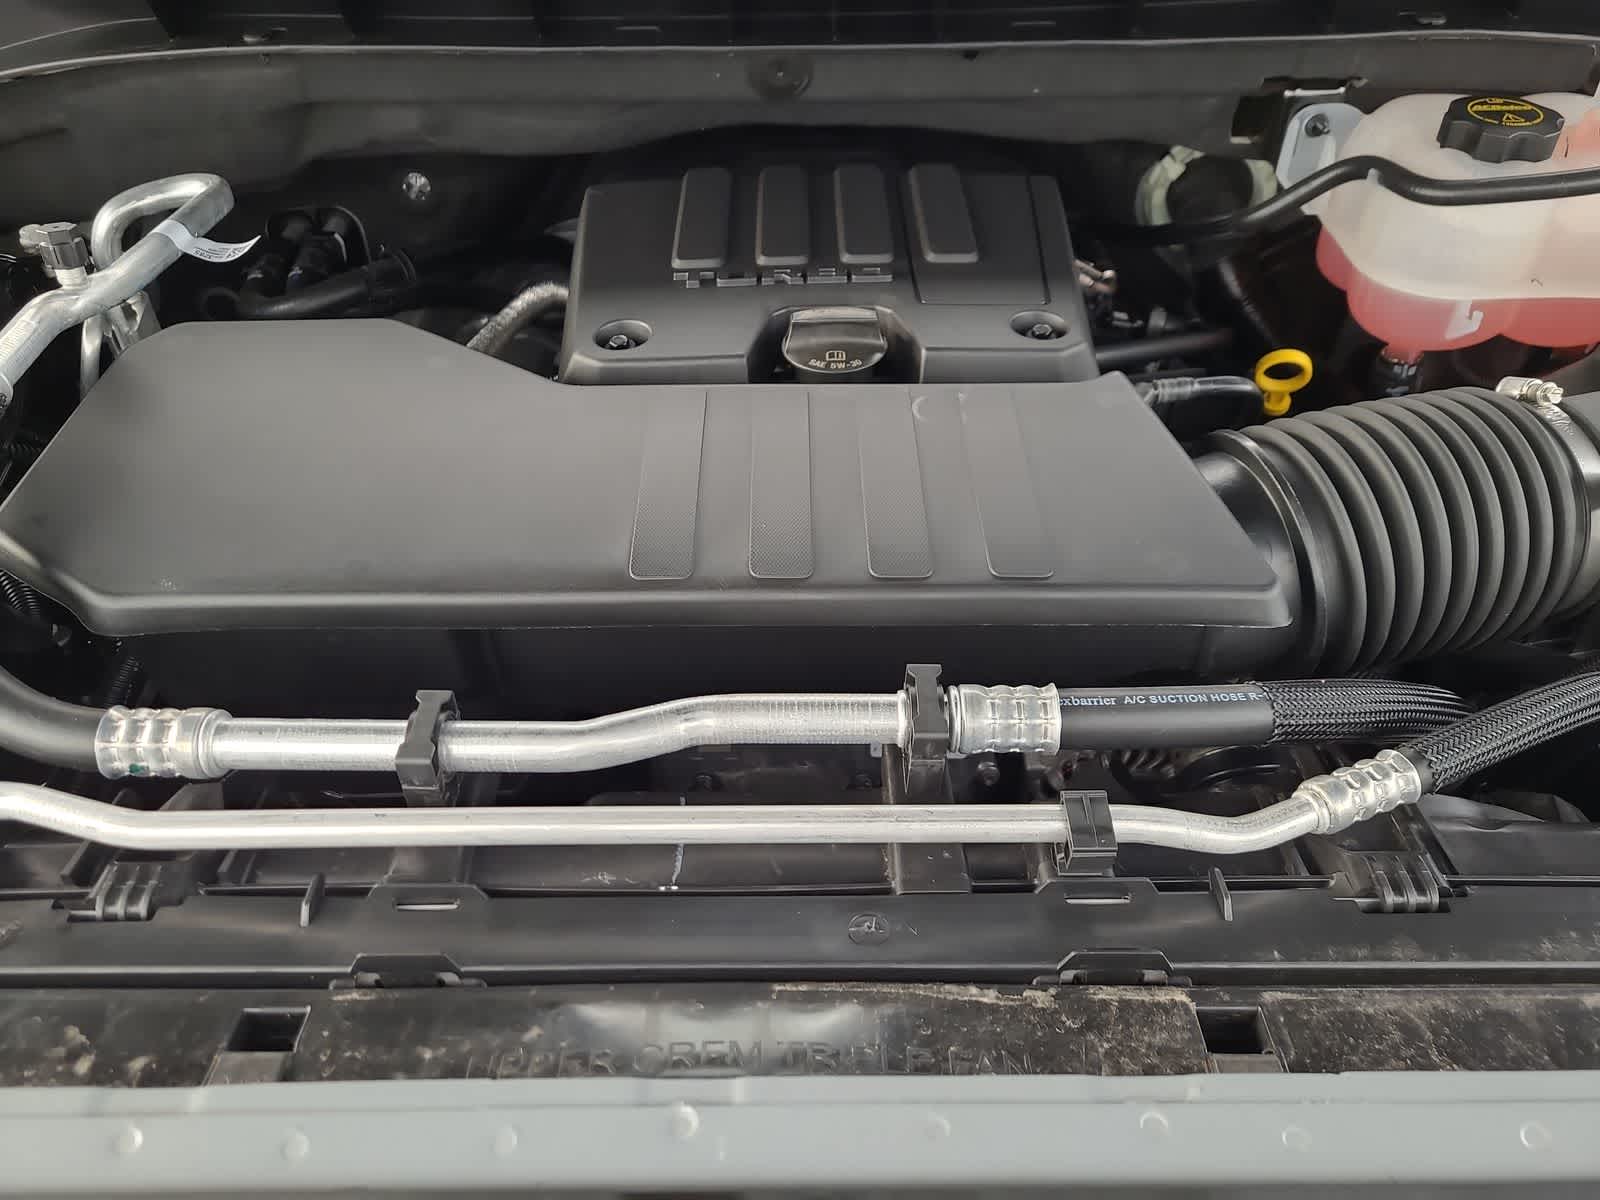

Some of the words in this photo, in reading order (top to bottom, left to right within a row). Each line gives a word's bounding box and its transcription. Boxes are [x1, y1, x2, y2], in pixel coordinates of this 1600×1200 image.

[672, 267, 893, 289] TURBO
[807, 358, 828, 368] SAE
[1124, 695, 1146, 704] A/C
[1149, 693, 1208, 704] SUCTION
[1210, 692, 1247, 702] HOSE
